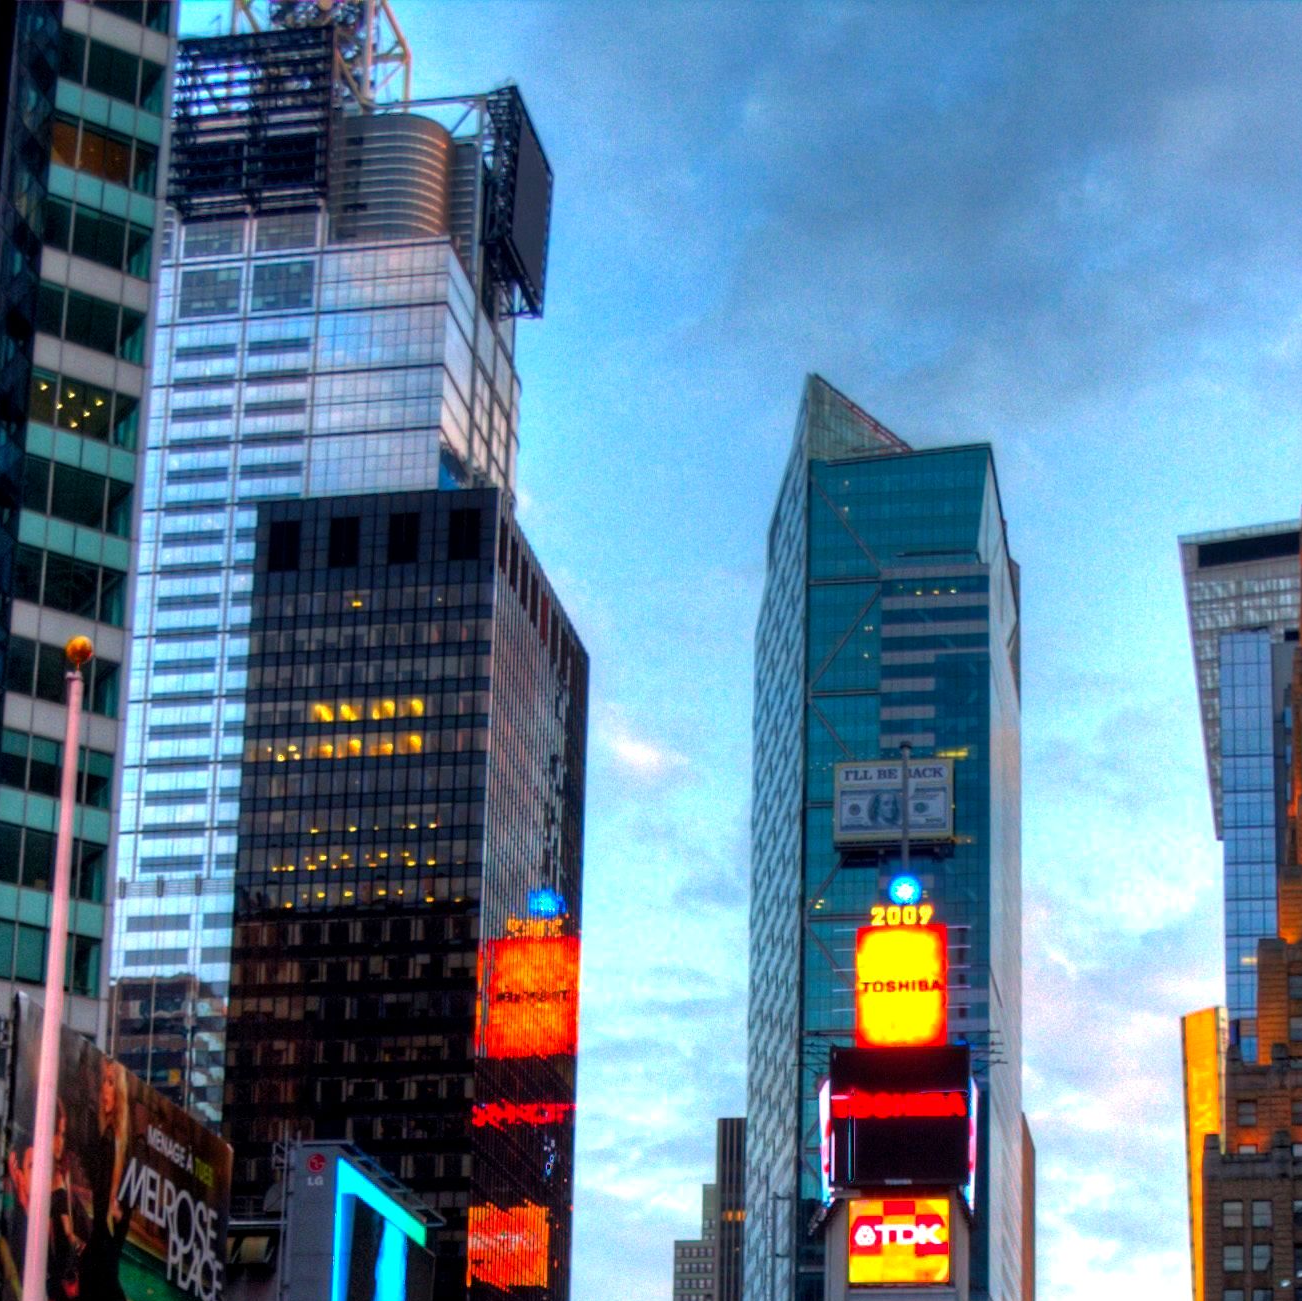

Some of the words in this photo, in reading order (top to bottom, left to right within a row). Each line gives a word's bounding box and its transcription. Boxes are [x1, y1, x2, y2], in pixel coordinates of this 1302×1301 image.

[877, 768, 898, 780] BE
[870, 905, 934, 926] 2009
[863, 980, 944, 993] TOSHIBA
[306, 1176, 324, 1187] LG
[117, 1156, 219, 1261] MELROSE
[875, 1223, 944, 1246] TDK
